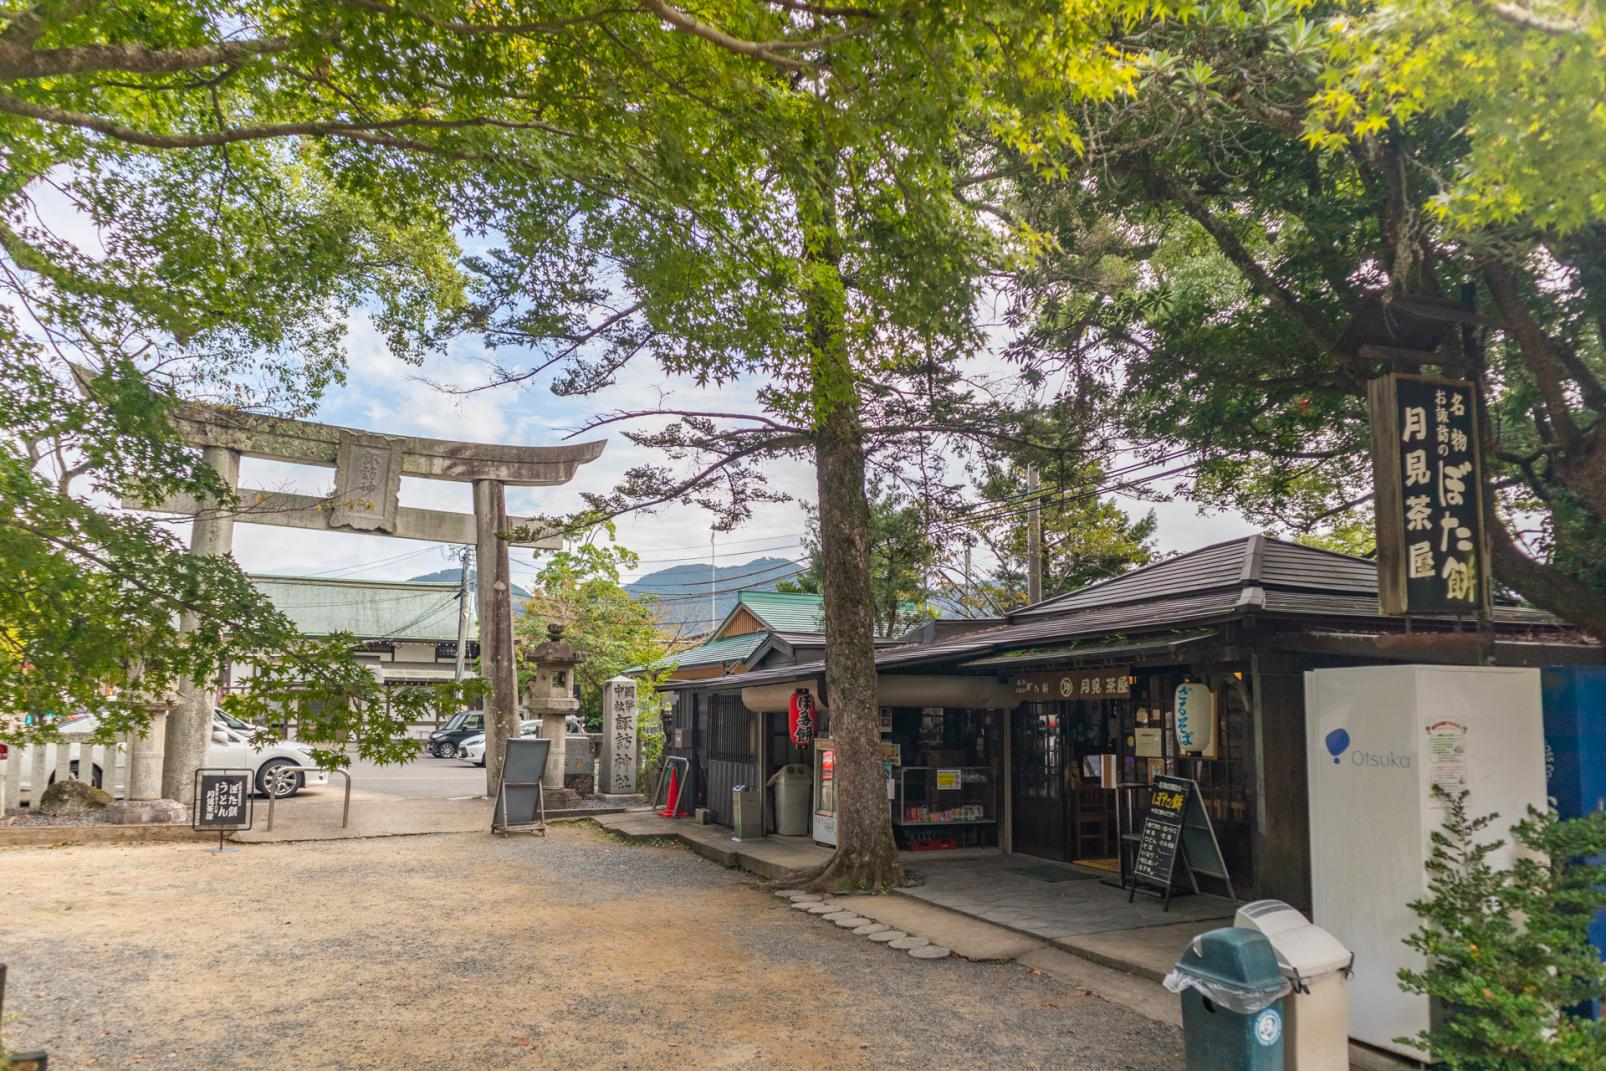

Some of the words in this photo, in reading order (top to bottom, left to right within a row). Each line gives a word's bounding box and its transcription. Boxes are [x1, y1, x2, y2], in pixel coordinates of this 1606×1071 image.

[1435, 389, 1449, 457] お諏訪の
[1450, 392, 1467, 452] 名物
[1402, 407, 1436, 579] 月見茶屋
[1438, 460, 1477, 602] ぼた餅
[1080, 676, 1129, 694] 月見茶屋
[1178, 687, 1194, 746] ざるそば
[615, 714, 634, 790] 諏訪神社
[1351, 750, 1411, 768] Otsuka
[206, 790, 214, 820] 月見茶屋
[218, 782, 228, 817] うどん
[228, 784, 238, 817] ぼた餅
[1151, 790, 1184, 813] ぼた餅
